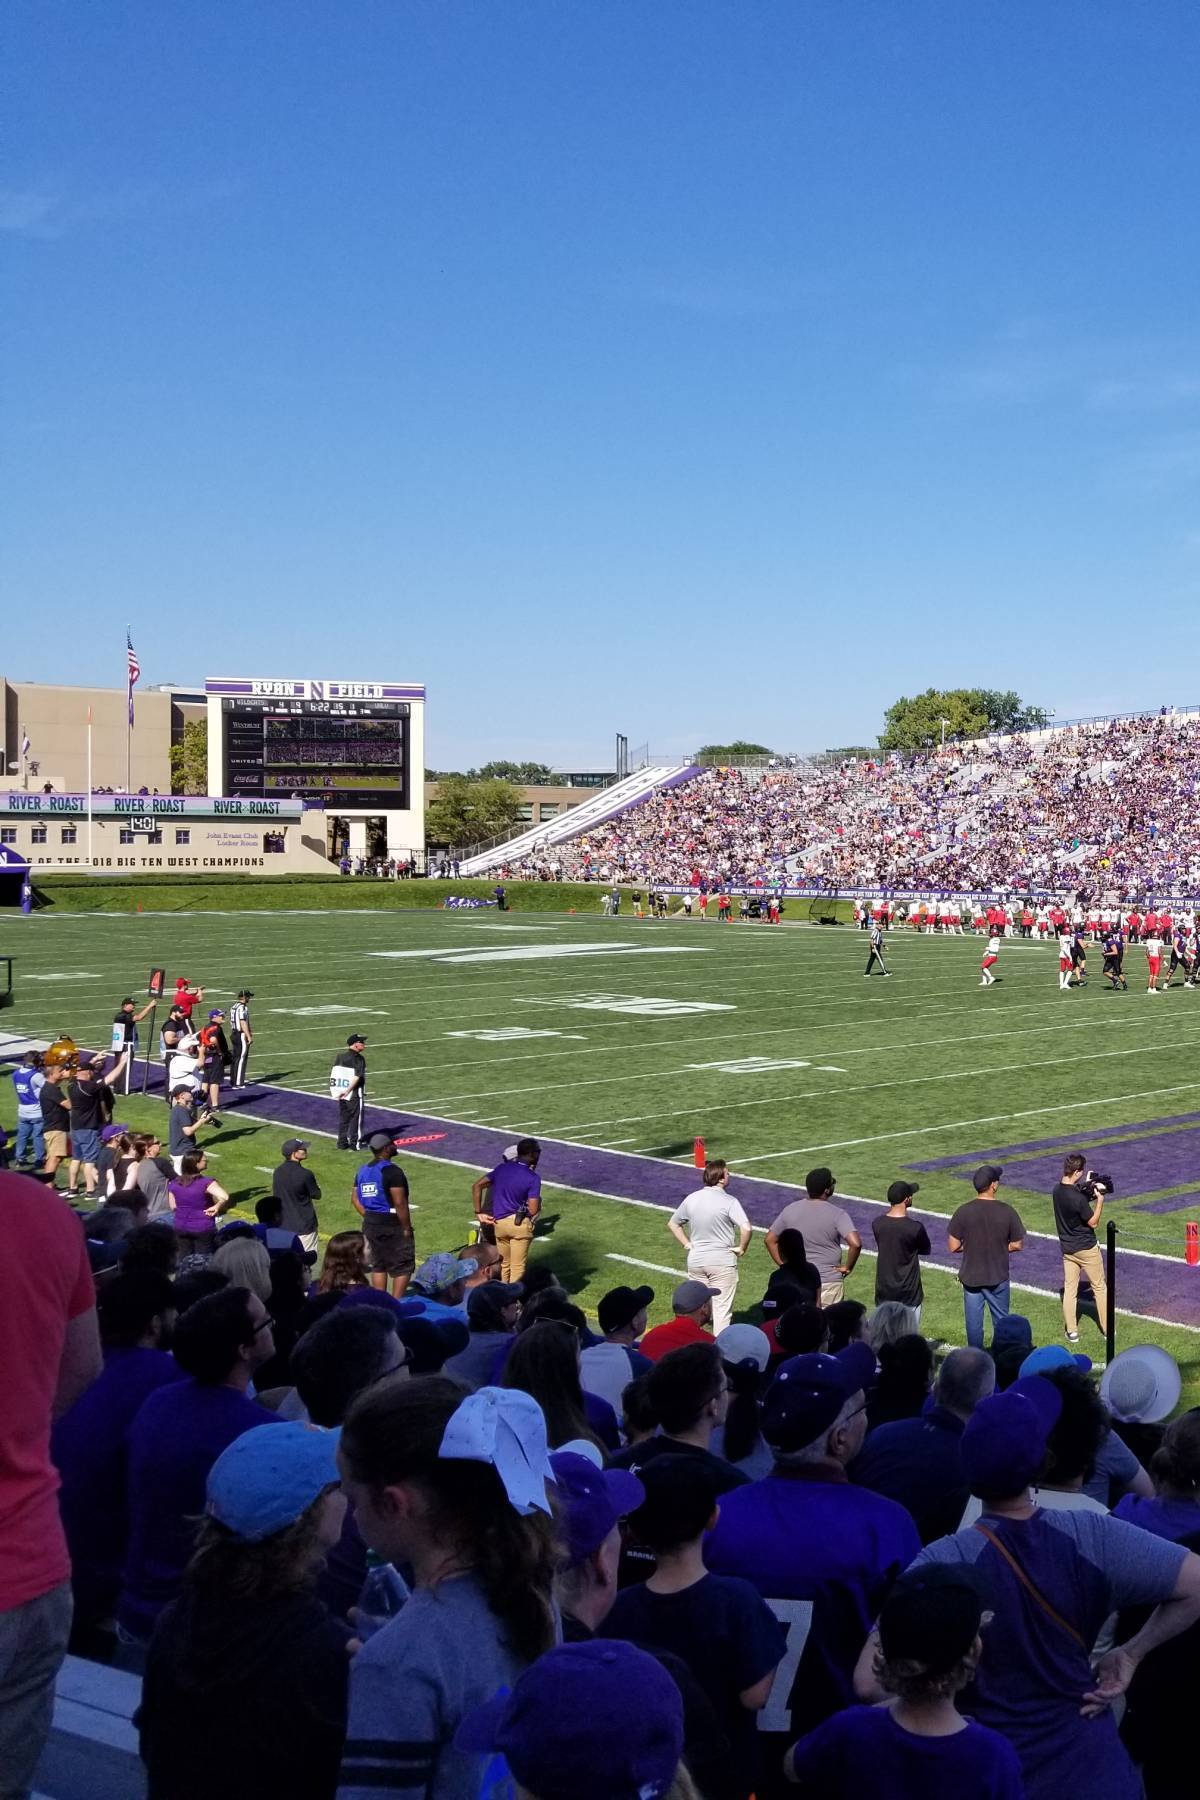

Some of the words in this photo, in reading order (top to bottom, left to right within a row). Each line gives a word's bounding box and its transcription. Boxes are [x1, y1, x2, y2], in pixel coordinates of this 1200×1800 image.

[252, 681, 295, 696] RYAN
[338, 684, 383, 698] FIELD
[9, 796, 41, 810] RIVER
[49, 797, 85, 811] ROAST
[115, 798, 144, 812] RIVER
[153, 800, 185, 812] ROAST
[214, 800, 241, 813] RIVER
[250, 801, 280, 814] ROAST
[118, 858, 136, 866] BIG
[141, 858, 162, 866] TEN
[168, 858, 198, 866] WEST
[203, 858, 264, 866] CHAMPIONS
[756, 1597, 814, 1731] 7
